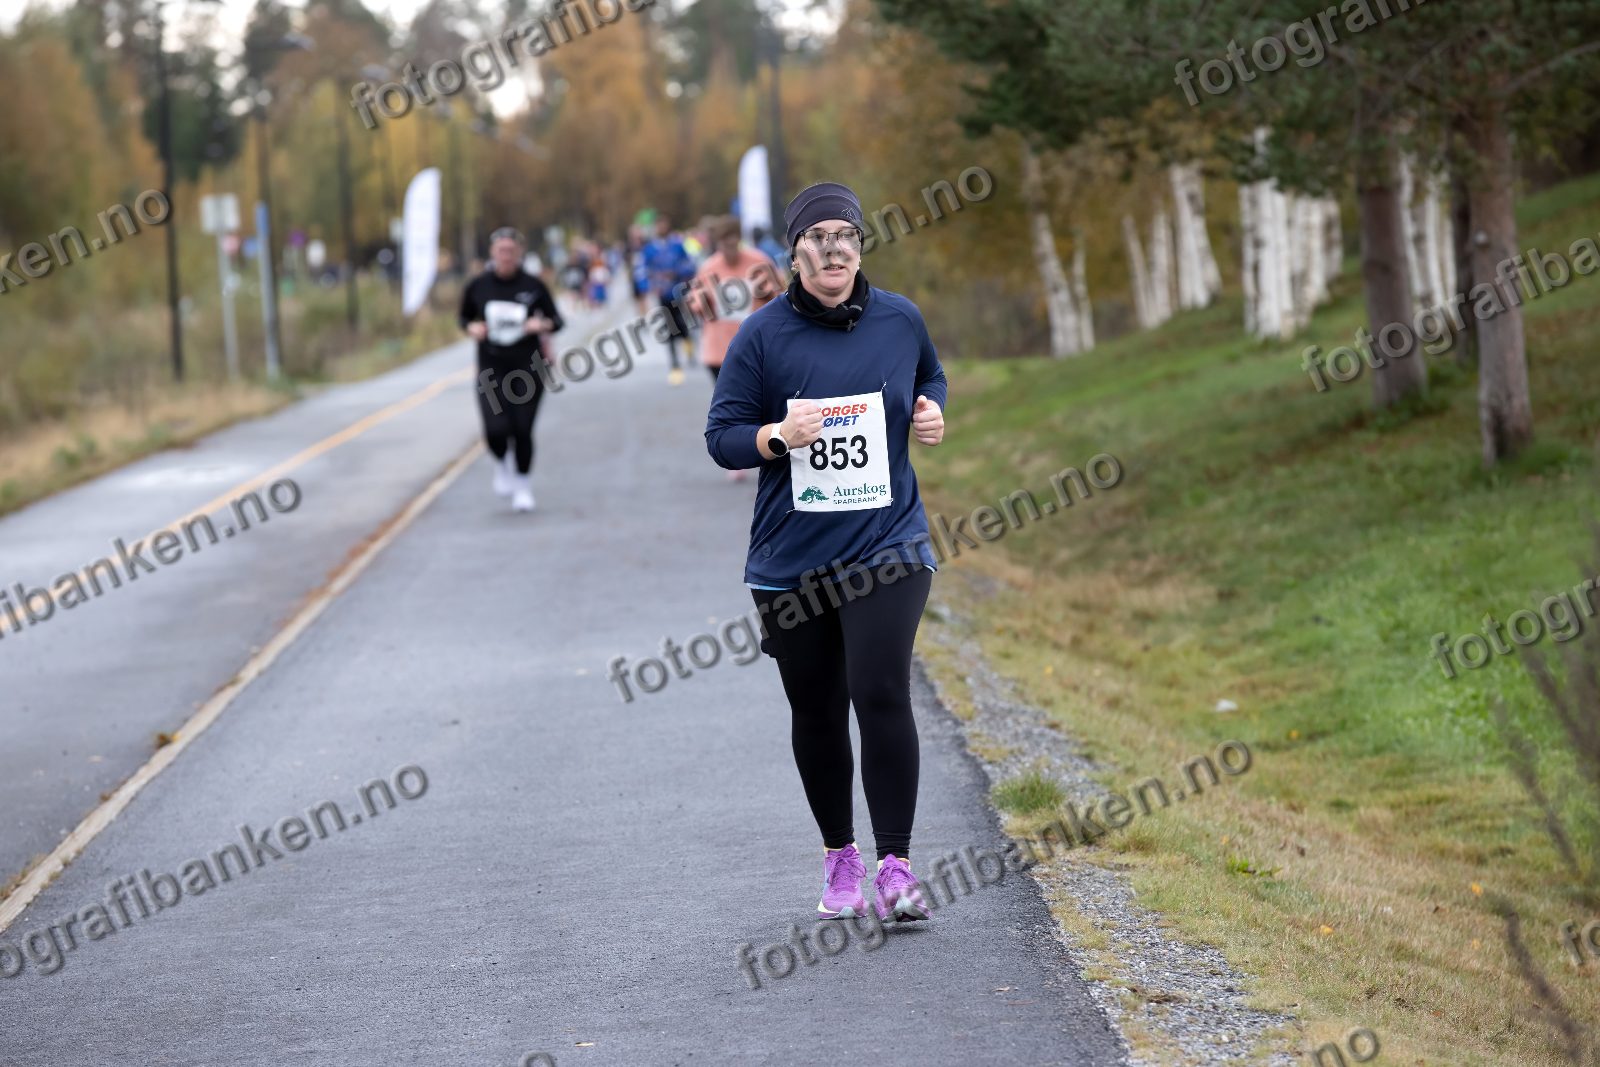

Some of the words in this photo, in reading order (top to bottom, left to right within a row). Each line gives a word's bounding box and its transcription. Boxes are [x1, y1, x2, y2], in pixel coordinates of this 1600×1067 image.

[819, 403, 868, 417] ORGES
[822, 415, 860, 428] ØPET
[809, 434, 869, 471] 853
[833, 482, 887, 497] Aurskog
